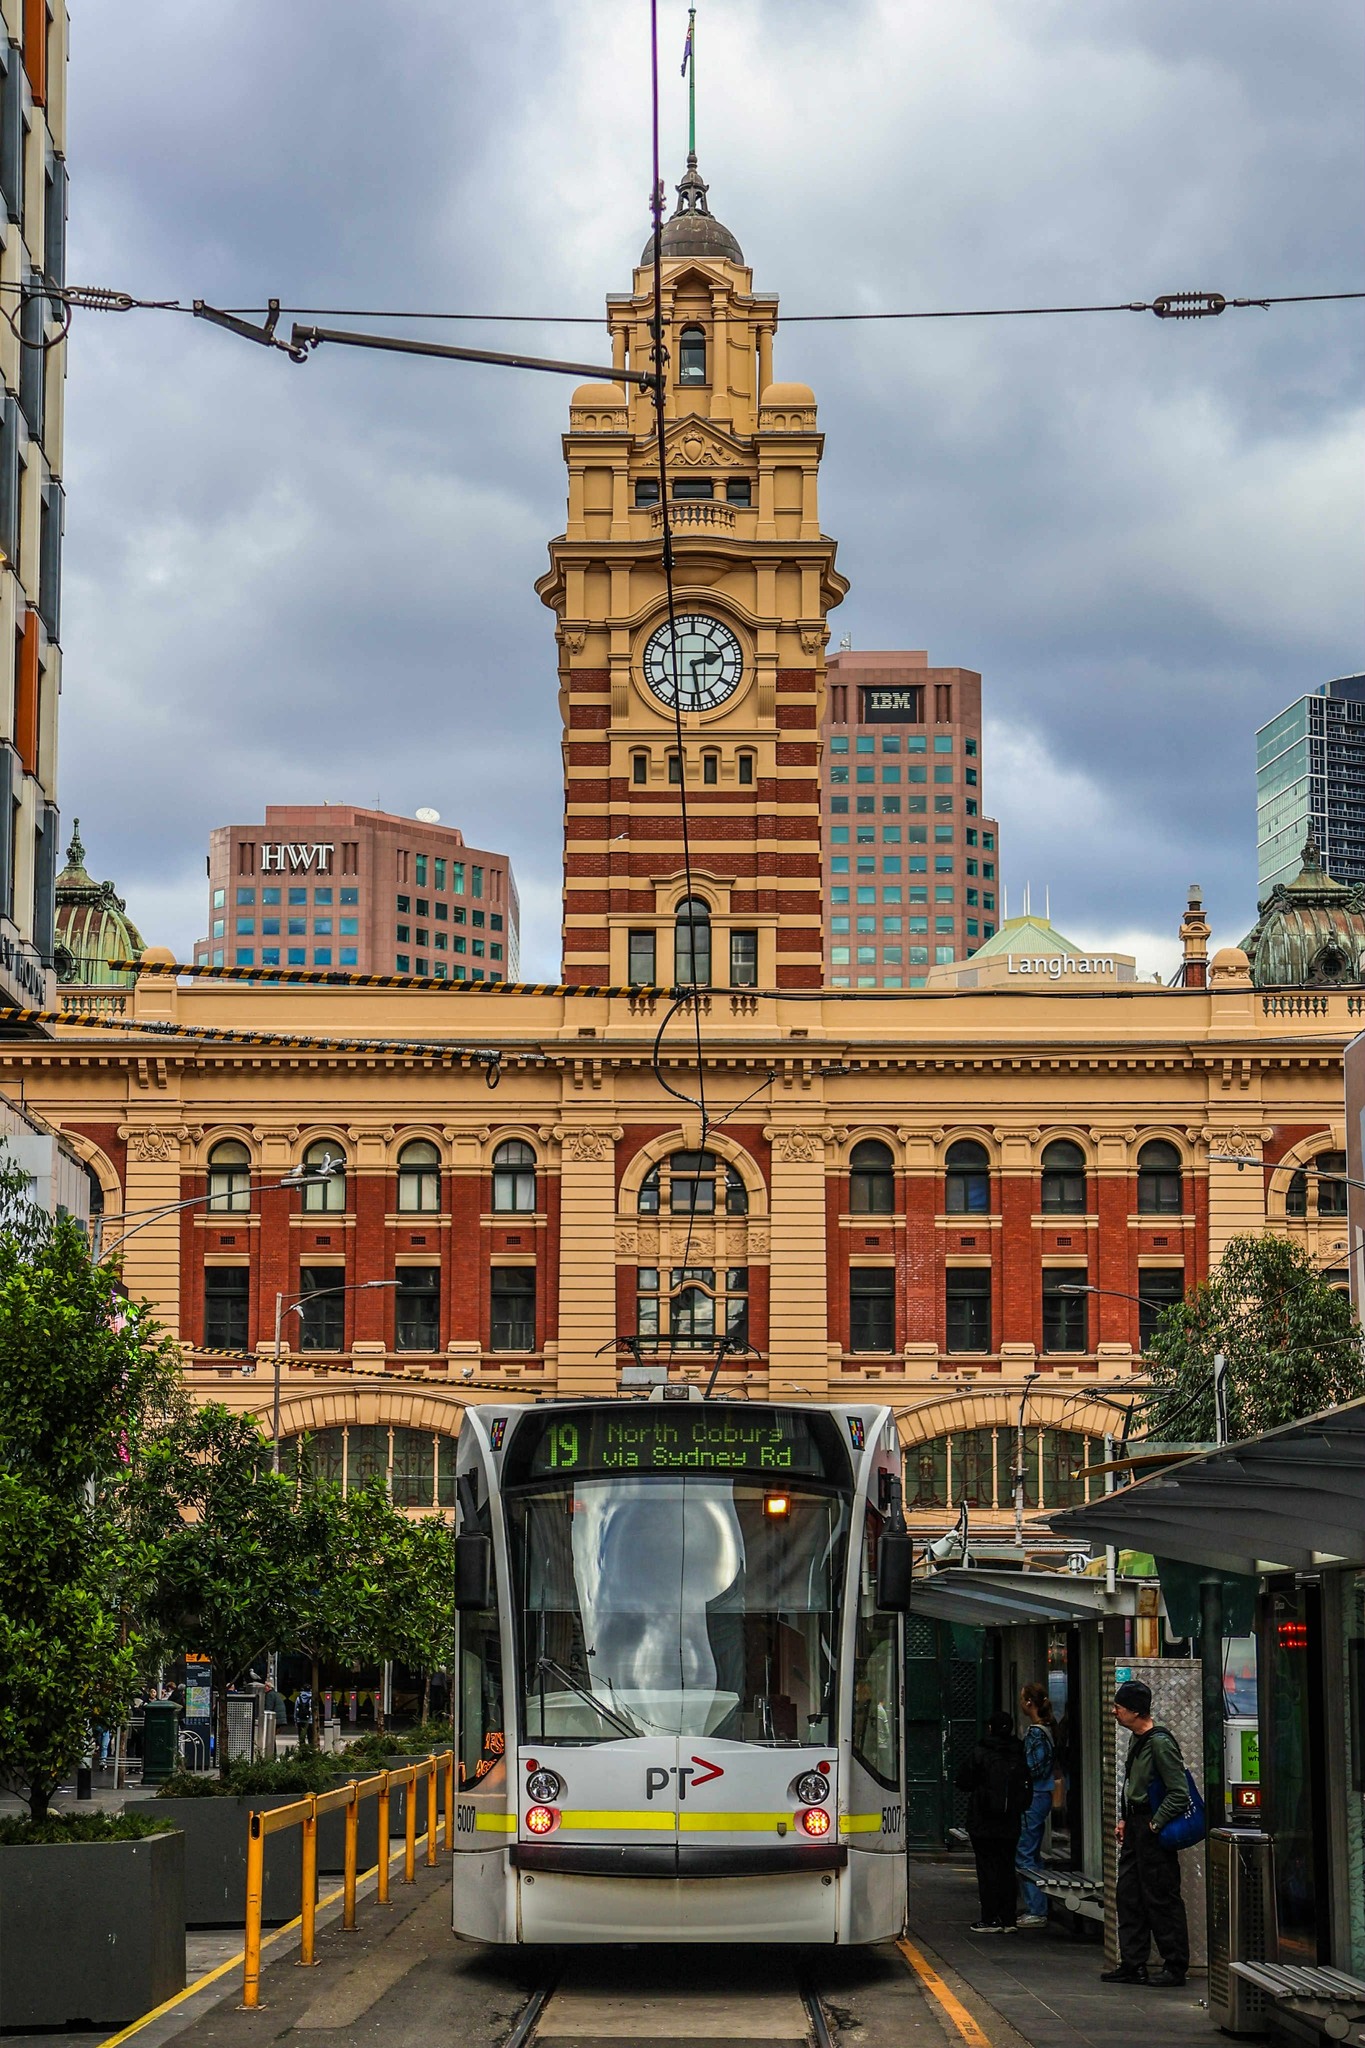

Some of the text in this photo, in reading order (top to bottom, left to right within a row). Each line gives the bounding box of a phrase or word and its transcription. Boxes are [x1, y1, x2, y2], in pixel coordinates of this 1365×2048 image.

[871, 692, 911, 709] IBM
[260, 844, 335, 870] HWT
[1007, 953, 1114, 980] Langham
[546, 1423, 578, 1467] 19
[608, 1423, 678, 1443] North
[603, 1446, 791, 1467] via Sydney Rd
[646, 1767, 695, 1800] PT
[457, 1804, 477, 1834] 5007
[882, 1806, 902, 1835] 5007
